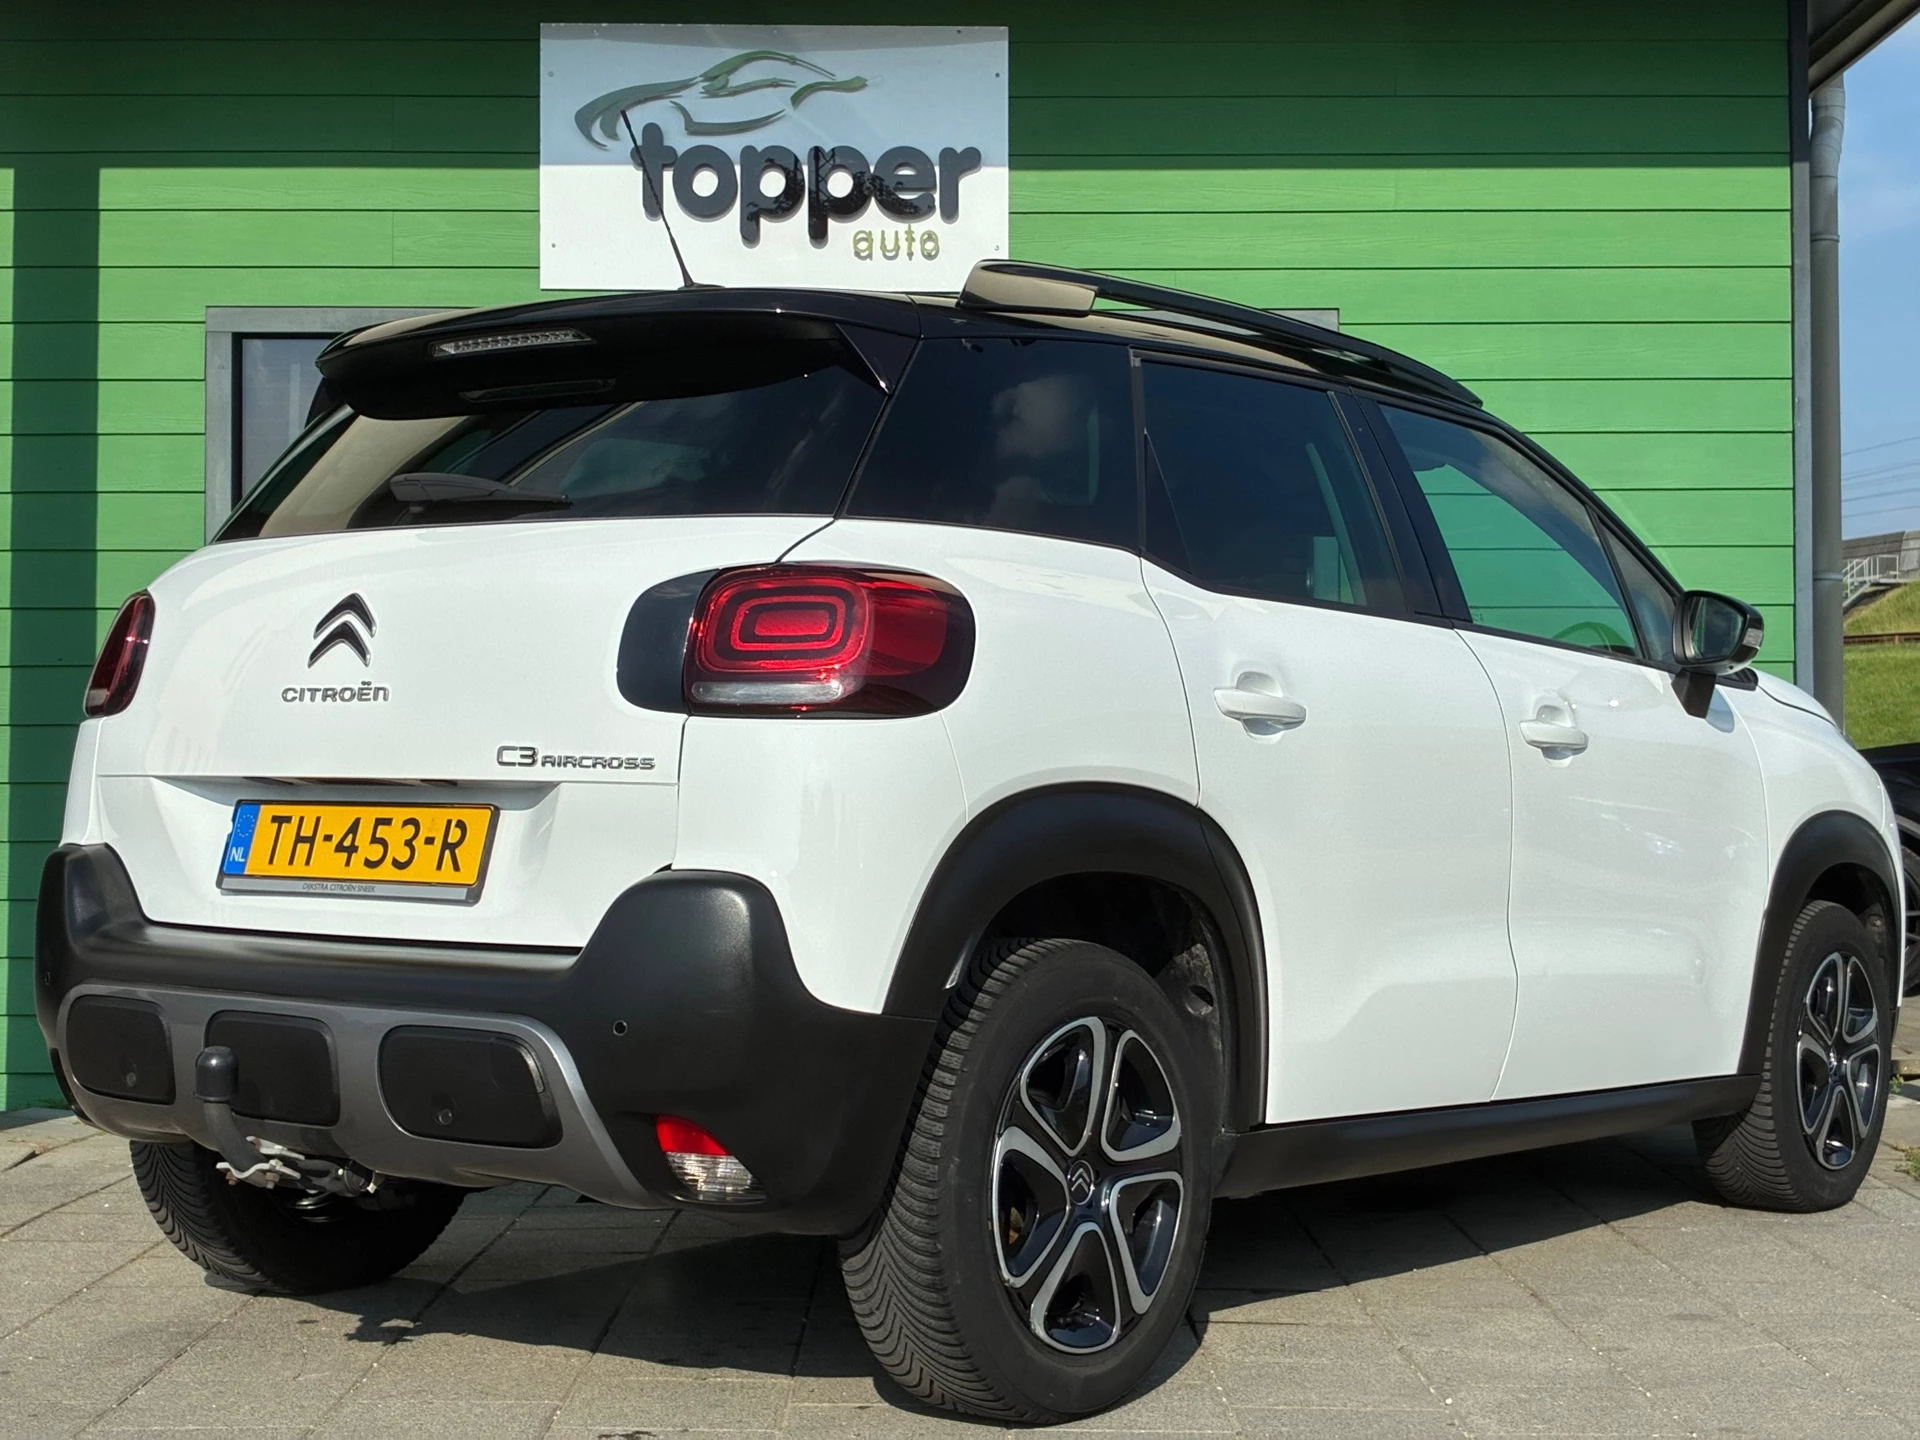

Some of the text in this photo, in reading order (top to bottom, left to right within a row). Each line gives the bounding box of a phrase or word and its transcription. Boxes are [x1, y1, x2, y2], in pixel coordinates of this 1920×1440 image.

[630, 122, 982, 246] topper
[853, 224, 940, 259] auto
[496, 745, 656, 770] C3 AIRCROSS
[229, 846, 246, 863] NL
[267, 814, 468, 873] TH-453-R
